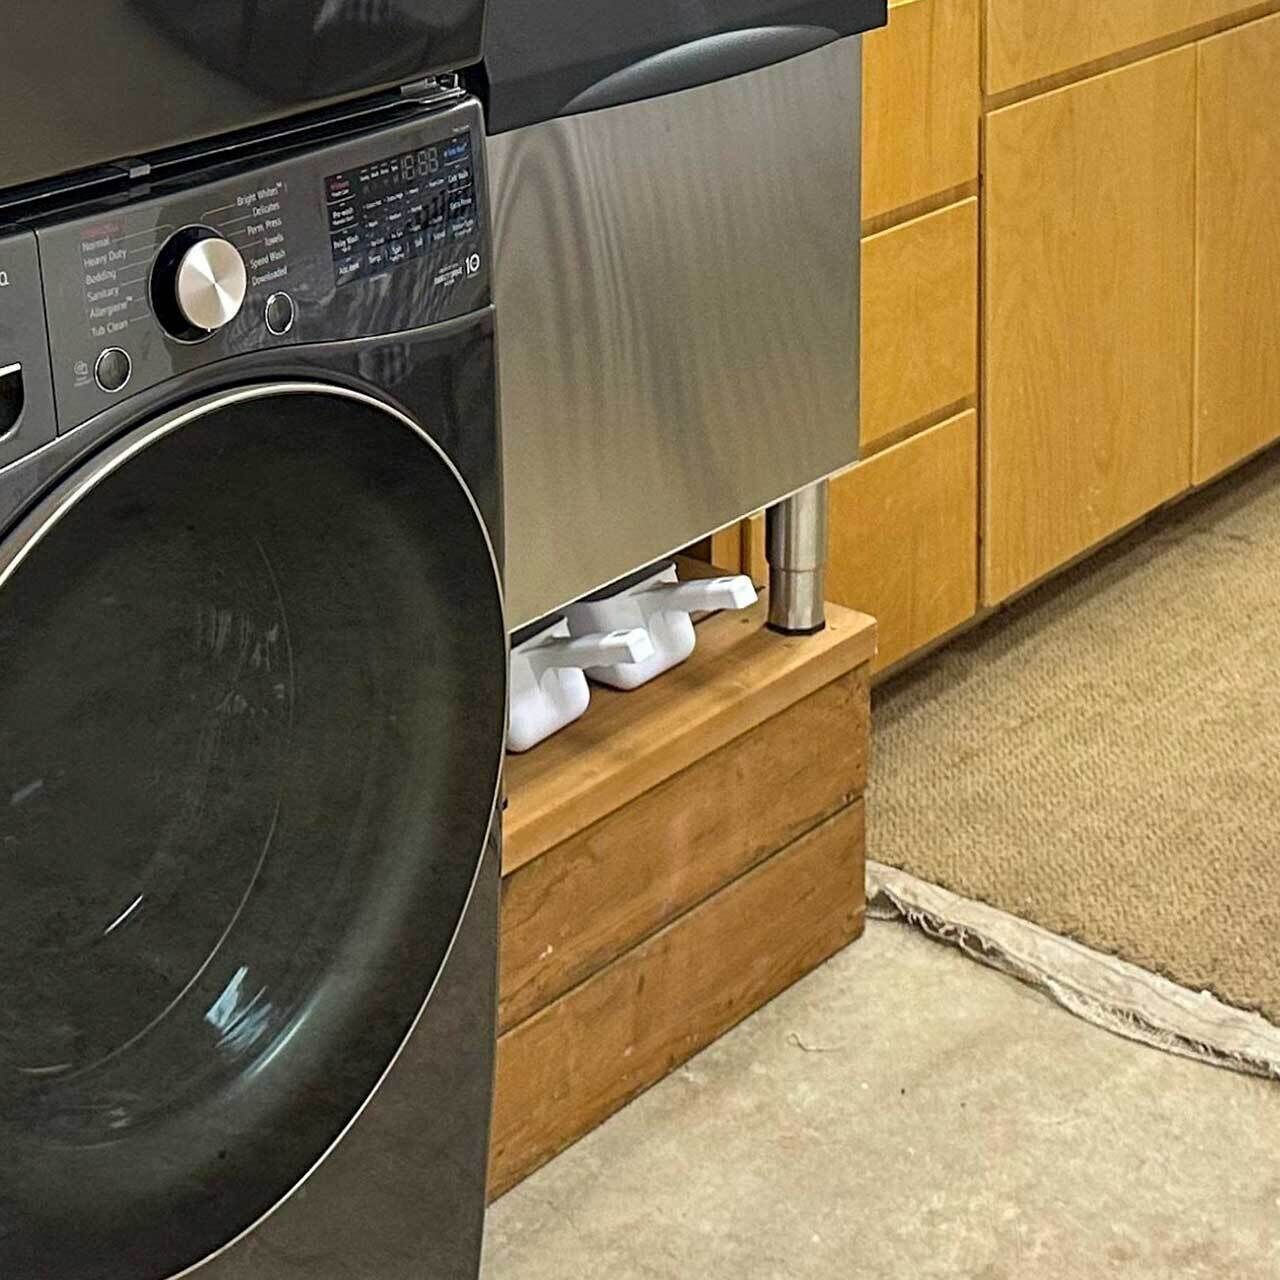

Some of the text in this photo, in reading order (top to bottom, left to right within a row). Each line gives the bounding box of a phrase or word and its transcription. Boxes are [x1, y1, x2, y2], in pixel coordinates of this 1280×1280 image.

[81, 237, 110, 252] Normal
[83, 248, 128, 269] Heavy Duty
[465, 253, 480, 275] 10
[91, 325, 105, 337] Tub
